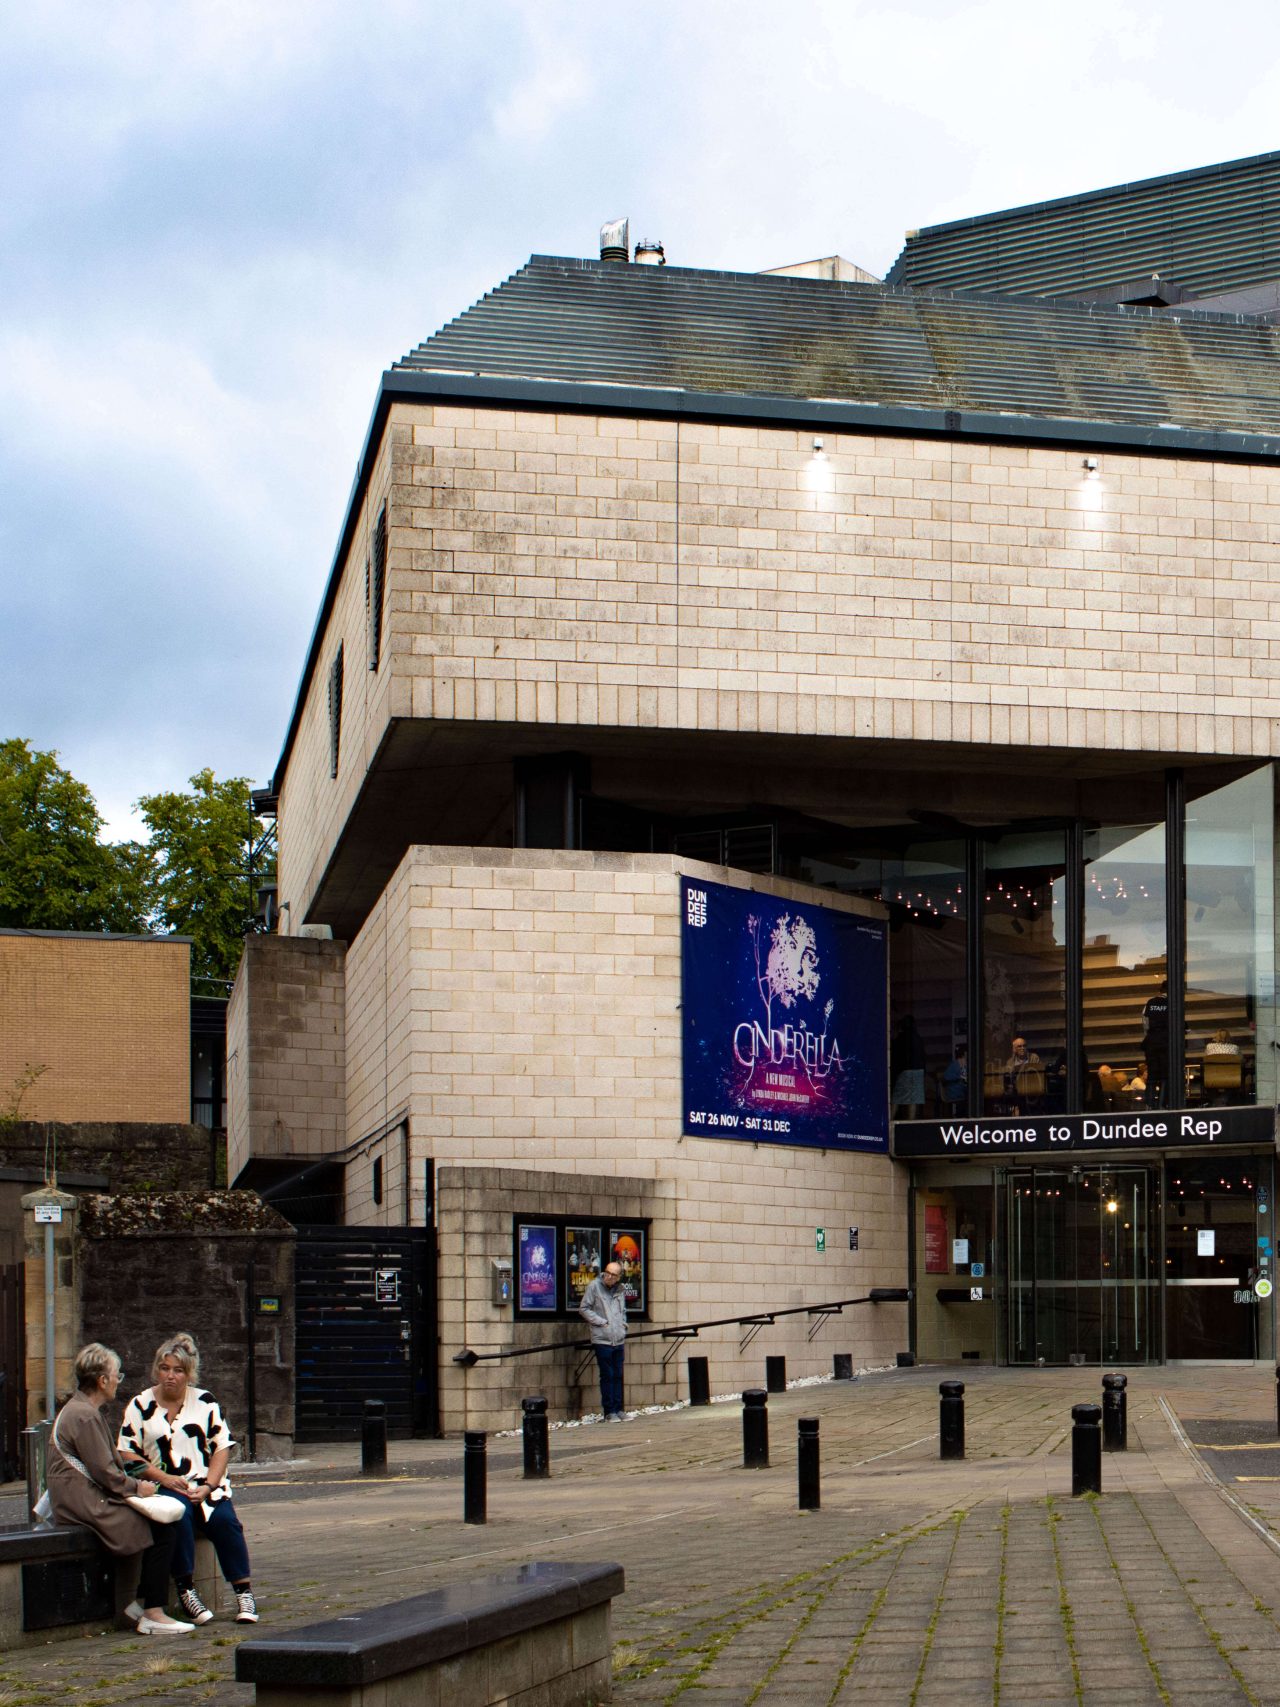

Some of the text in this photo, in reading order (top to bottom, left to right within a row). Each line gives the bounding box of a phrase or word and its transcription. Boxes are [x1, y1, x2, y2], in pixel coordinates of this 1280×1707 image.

[687, 888, 707, 904] DUN
[687, 902, 707, 916] DEE
[687, 913, 707, 928] REP
[733, 1020, 846, 1077] CINDERELLA
[689, 1111, 706, 1124] SAT
[707, 1112, 719, 1126] 26
[720, 1114, 739, 1128] NOV
[745, 1117, 761, 1130] SAT
[763, 1119, 773, 1131] 31
[774, 1120, 791, 1133] DEC
[940, 1116, 1223, 1146] Welcome to Dundee Rep
